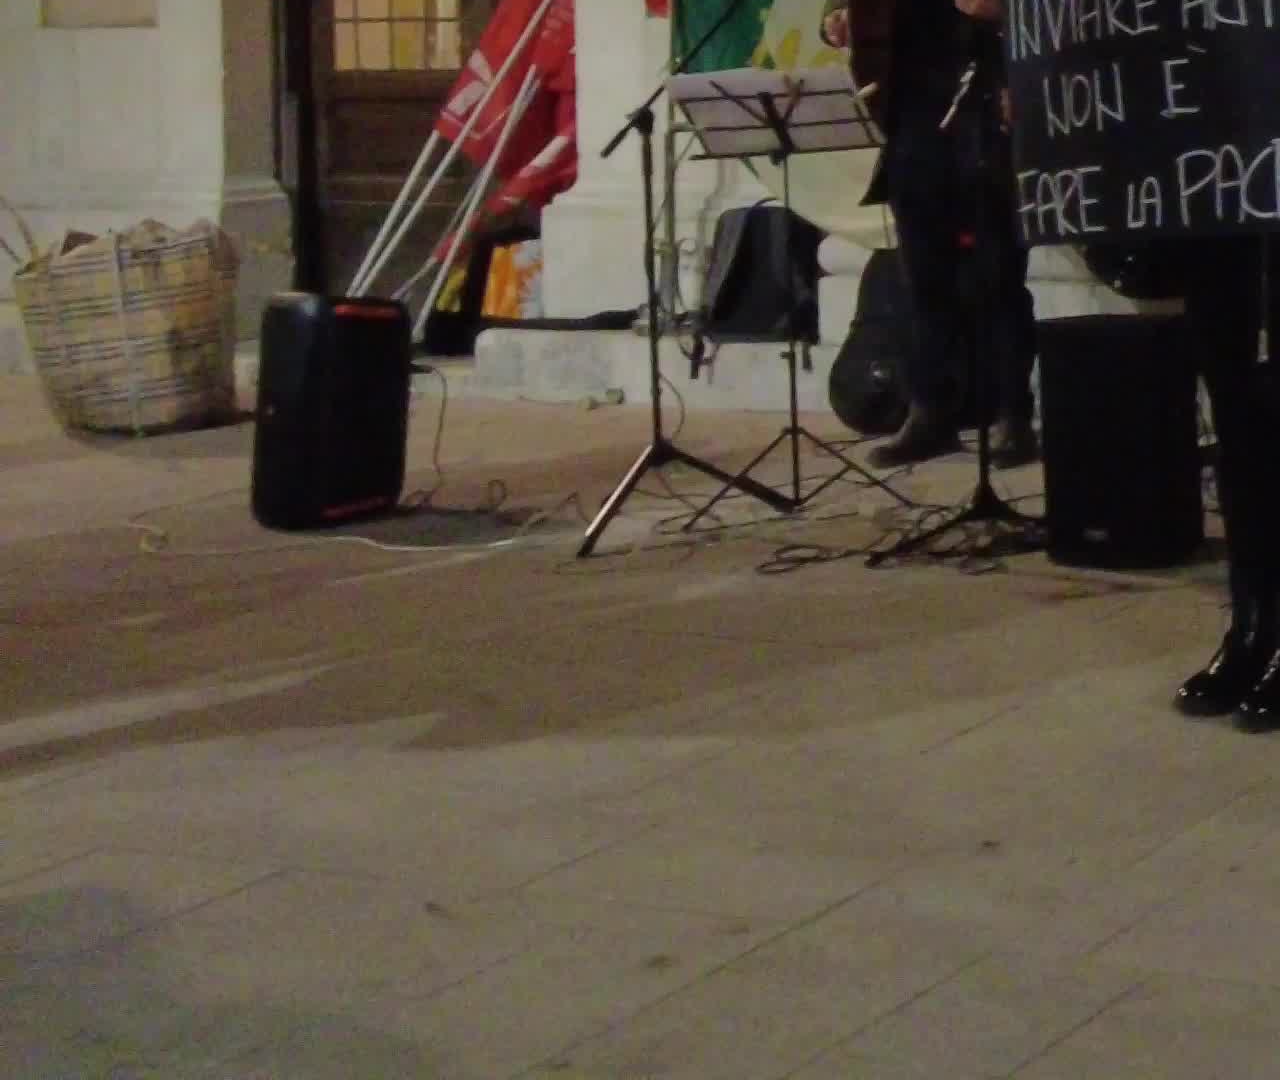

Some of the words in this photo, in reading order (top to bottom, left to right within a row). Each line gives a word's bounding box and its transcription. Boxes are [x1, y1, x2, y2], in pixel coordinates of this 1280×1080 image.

[1043, 62, 1127, 138] NON
[1160, 41, 1208, 119] È
[1016, 165, 1107, 240] FARE
[1125, 175, 1164, 228] LA
